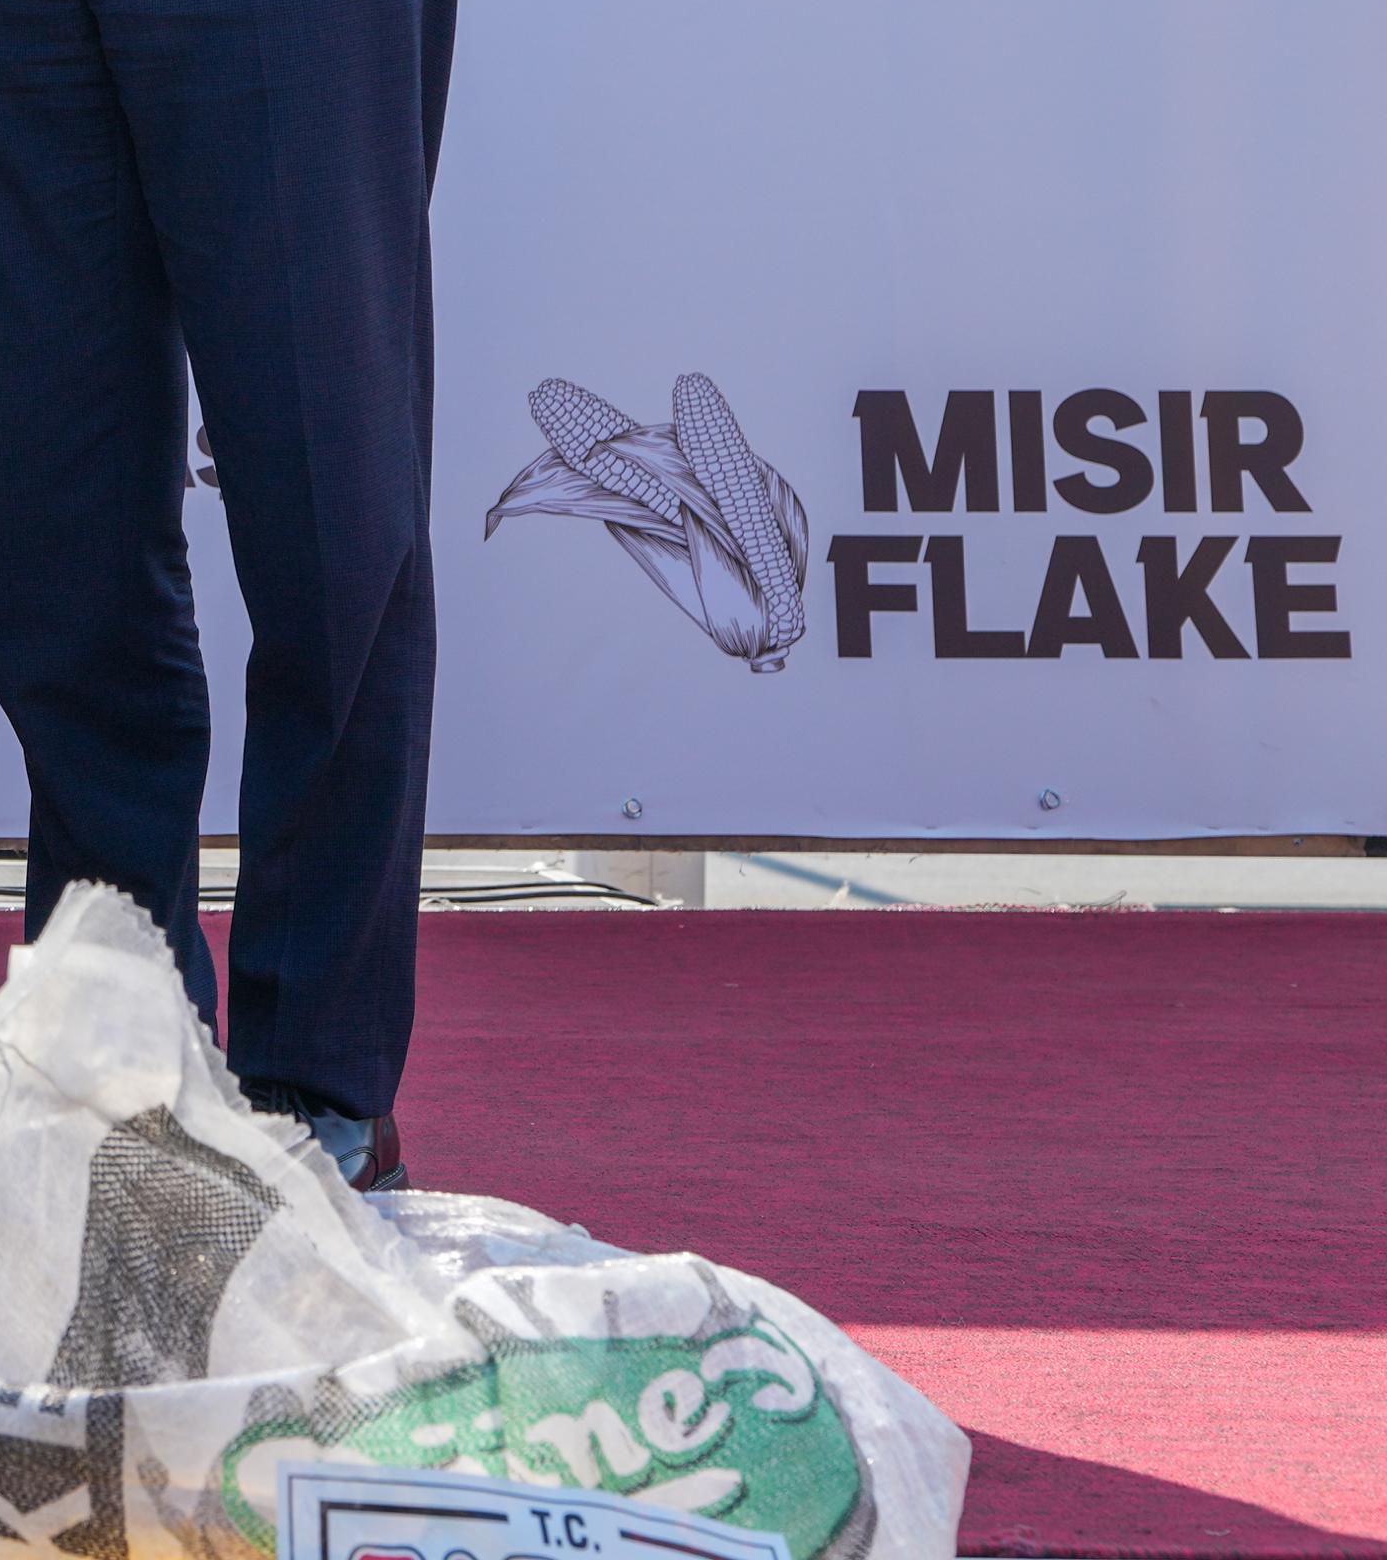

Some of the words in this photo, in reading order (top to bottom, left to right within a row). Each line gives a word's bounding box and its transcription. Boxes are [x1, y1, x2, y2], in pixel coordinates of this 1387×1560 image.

[852, 387, 1314, 515] MISIR
[827, 534, 1353, 659] FLAKE
[532, 1510, 601, 1553] T.C.
